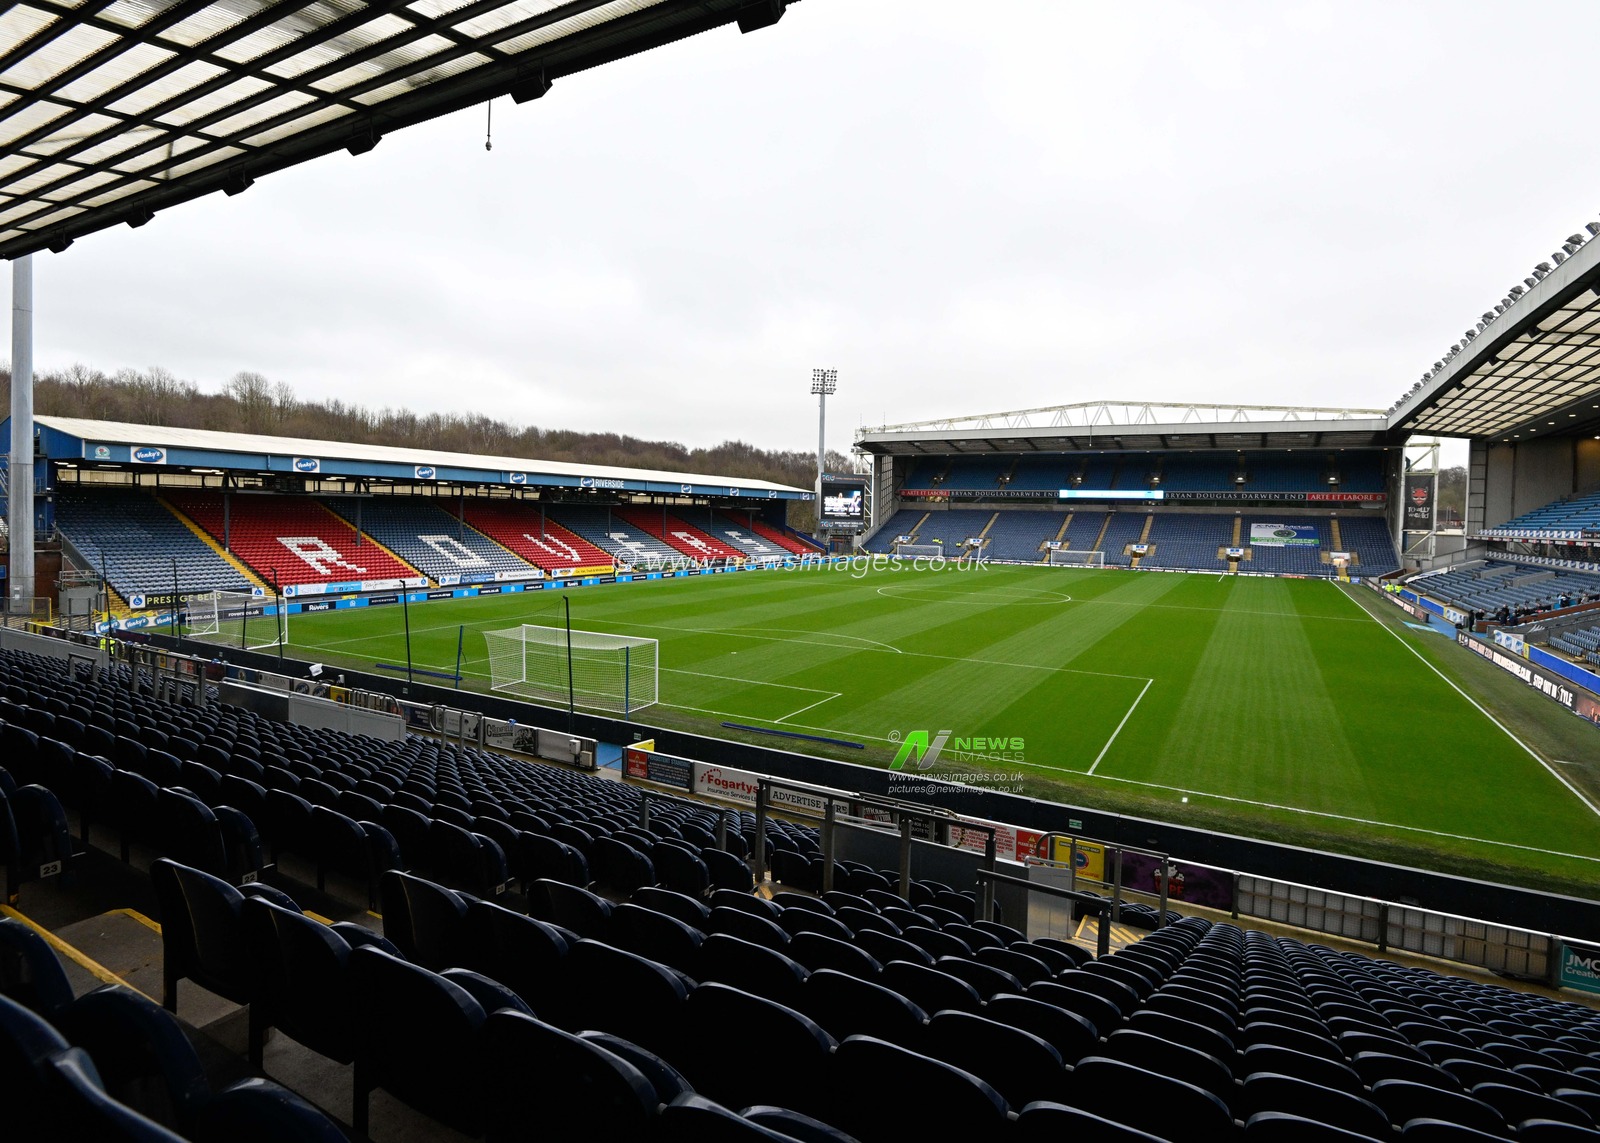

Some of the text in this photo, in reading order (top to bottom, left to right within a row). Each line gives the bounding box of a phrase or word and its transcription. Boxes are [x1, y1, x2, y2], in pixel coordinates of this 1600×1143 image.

[137, 450, 161, 459] Venky's
[595, 478, 624, 488] RIVERSIDE
[147, 595, 194, 605] PRESTGE
[127, 619, 146, 628] Venky's
[707, 774, 760, 794] Fogartys
[707, 786, 729, 797] Insurance
[730, 790, 751, 801] Services
[772, 790, 822, 809] ADVERTISE
[43, 864, 58, 875] 23
[244, 874, 255, 883] 22
